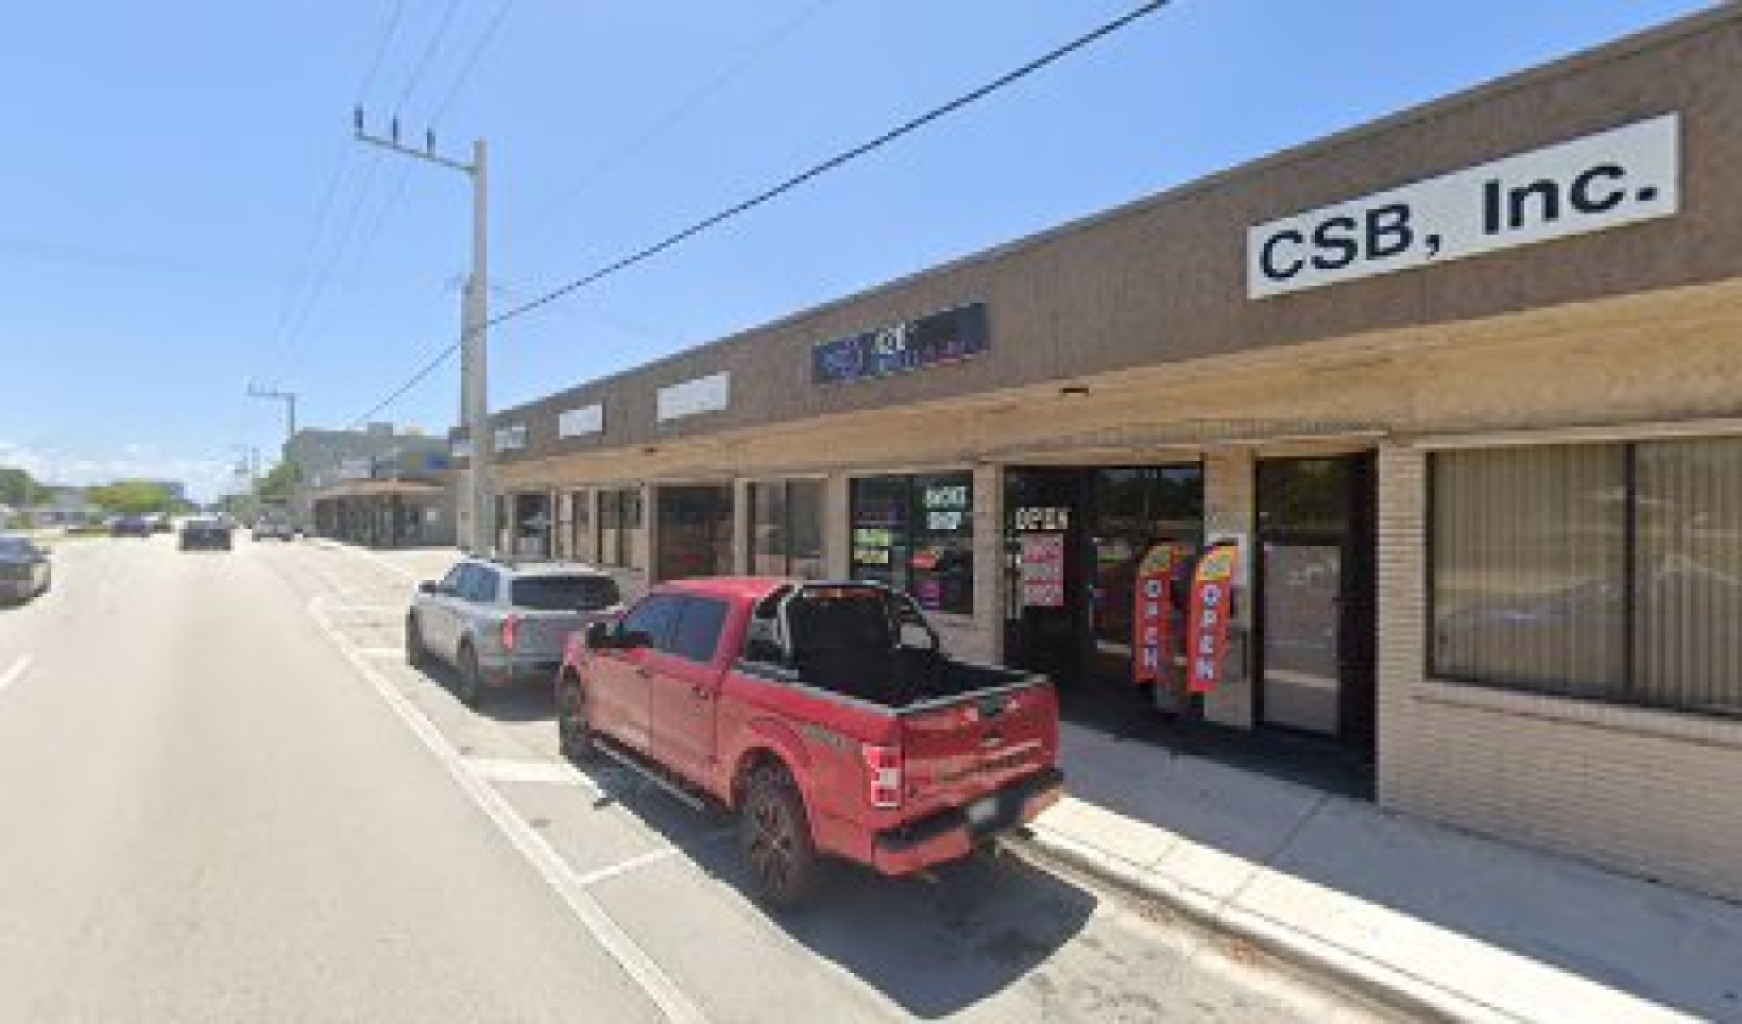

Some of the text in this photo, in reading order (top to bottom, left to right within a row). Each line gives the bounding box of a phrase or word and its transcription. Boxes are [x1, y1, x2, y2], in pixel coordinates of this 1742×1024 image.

[1259, 162, 1658, 281] CSB, Inc.
[1015, 506, 1070, 530] OPEN
[1144, 579, 1163, 672] OPEN
[1195, 583, 1222, 681] OPEN
